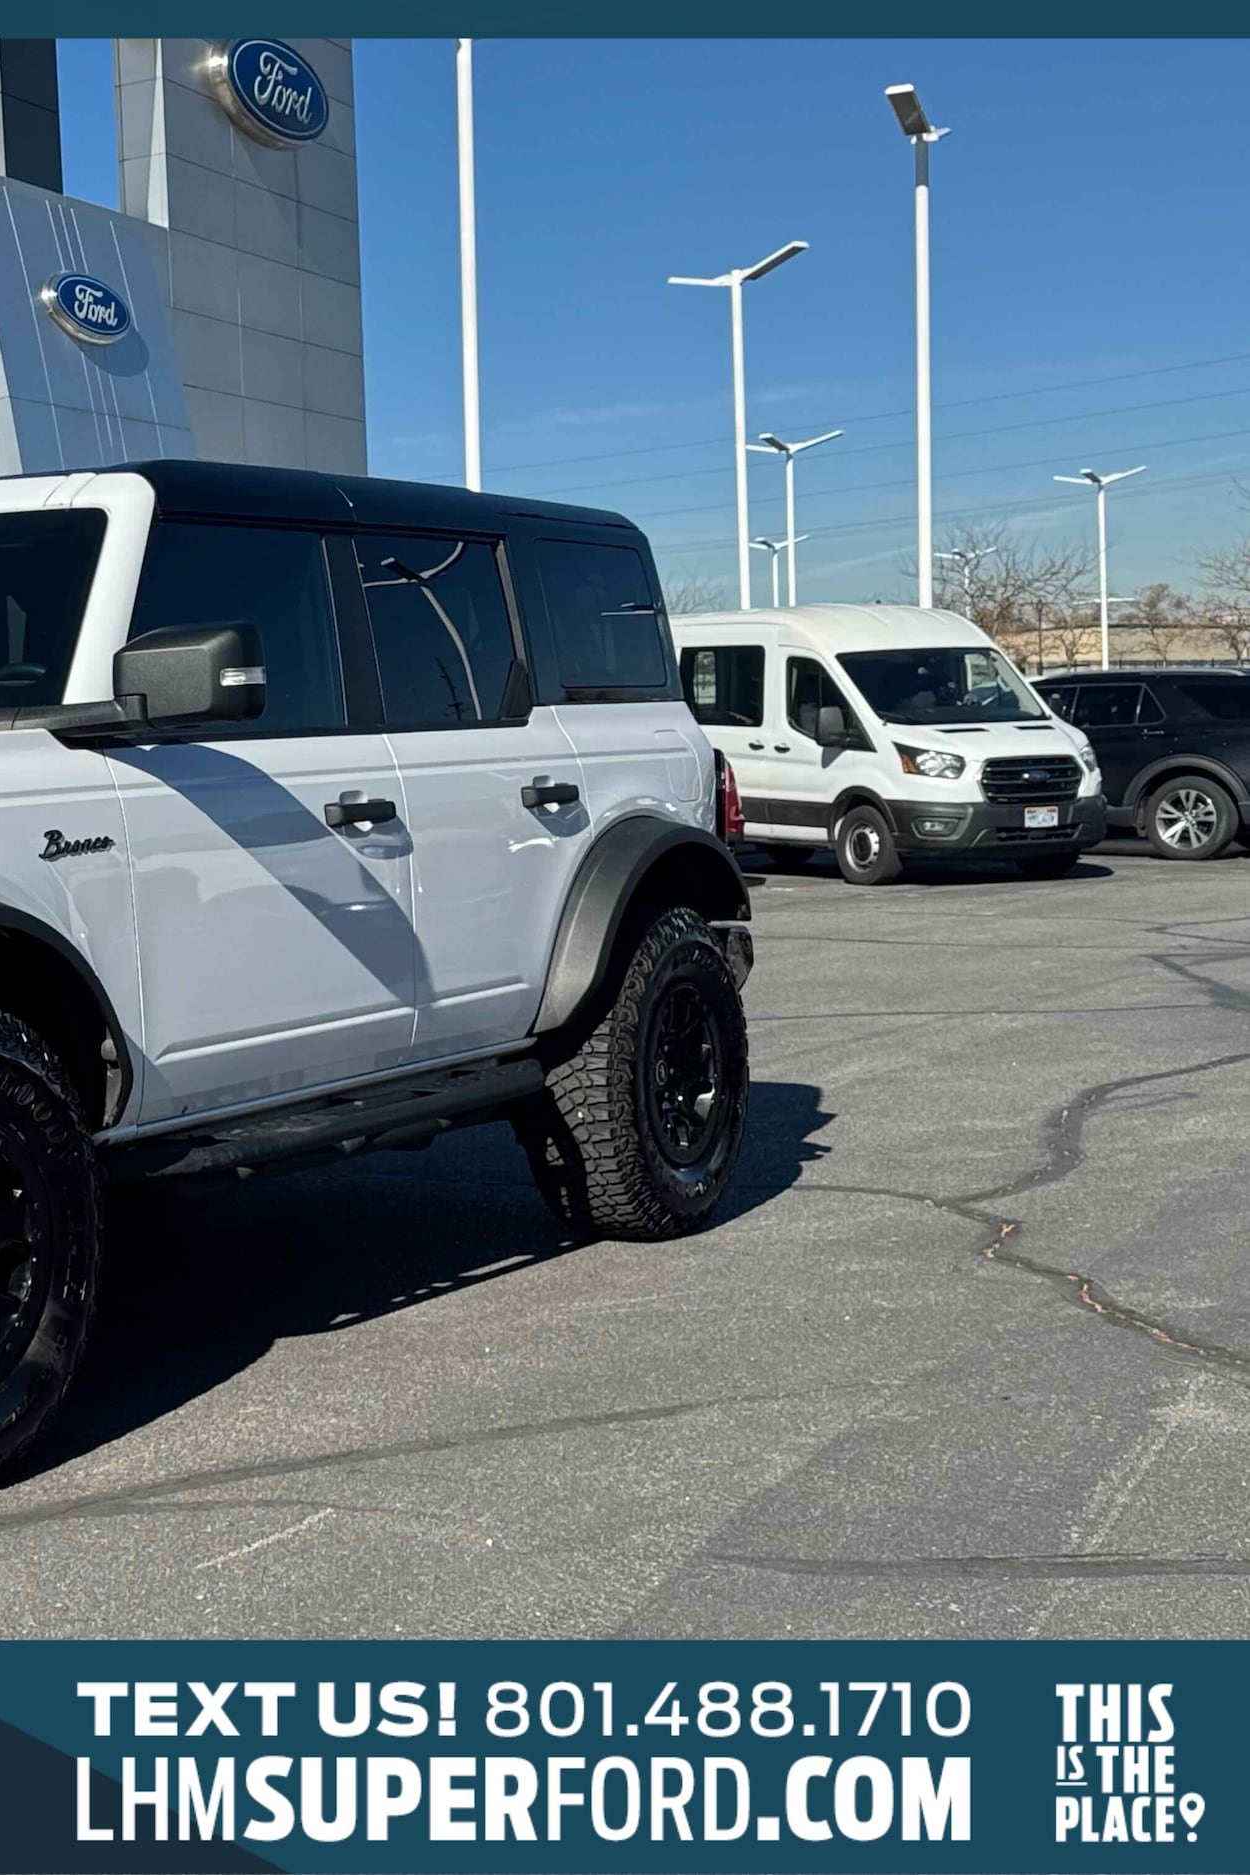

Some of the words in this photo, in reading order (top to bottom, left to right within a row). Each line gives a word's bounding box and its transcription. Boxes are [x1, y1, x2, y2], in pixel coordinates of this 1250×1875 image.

[253, 51, 313, 125] Ford
[73, 284, 118, 328] Ford
[38, 829, 116, 862] Bronco
